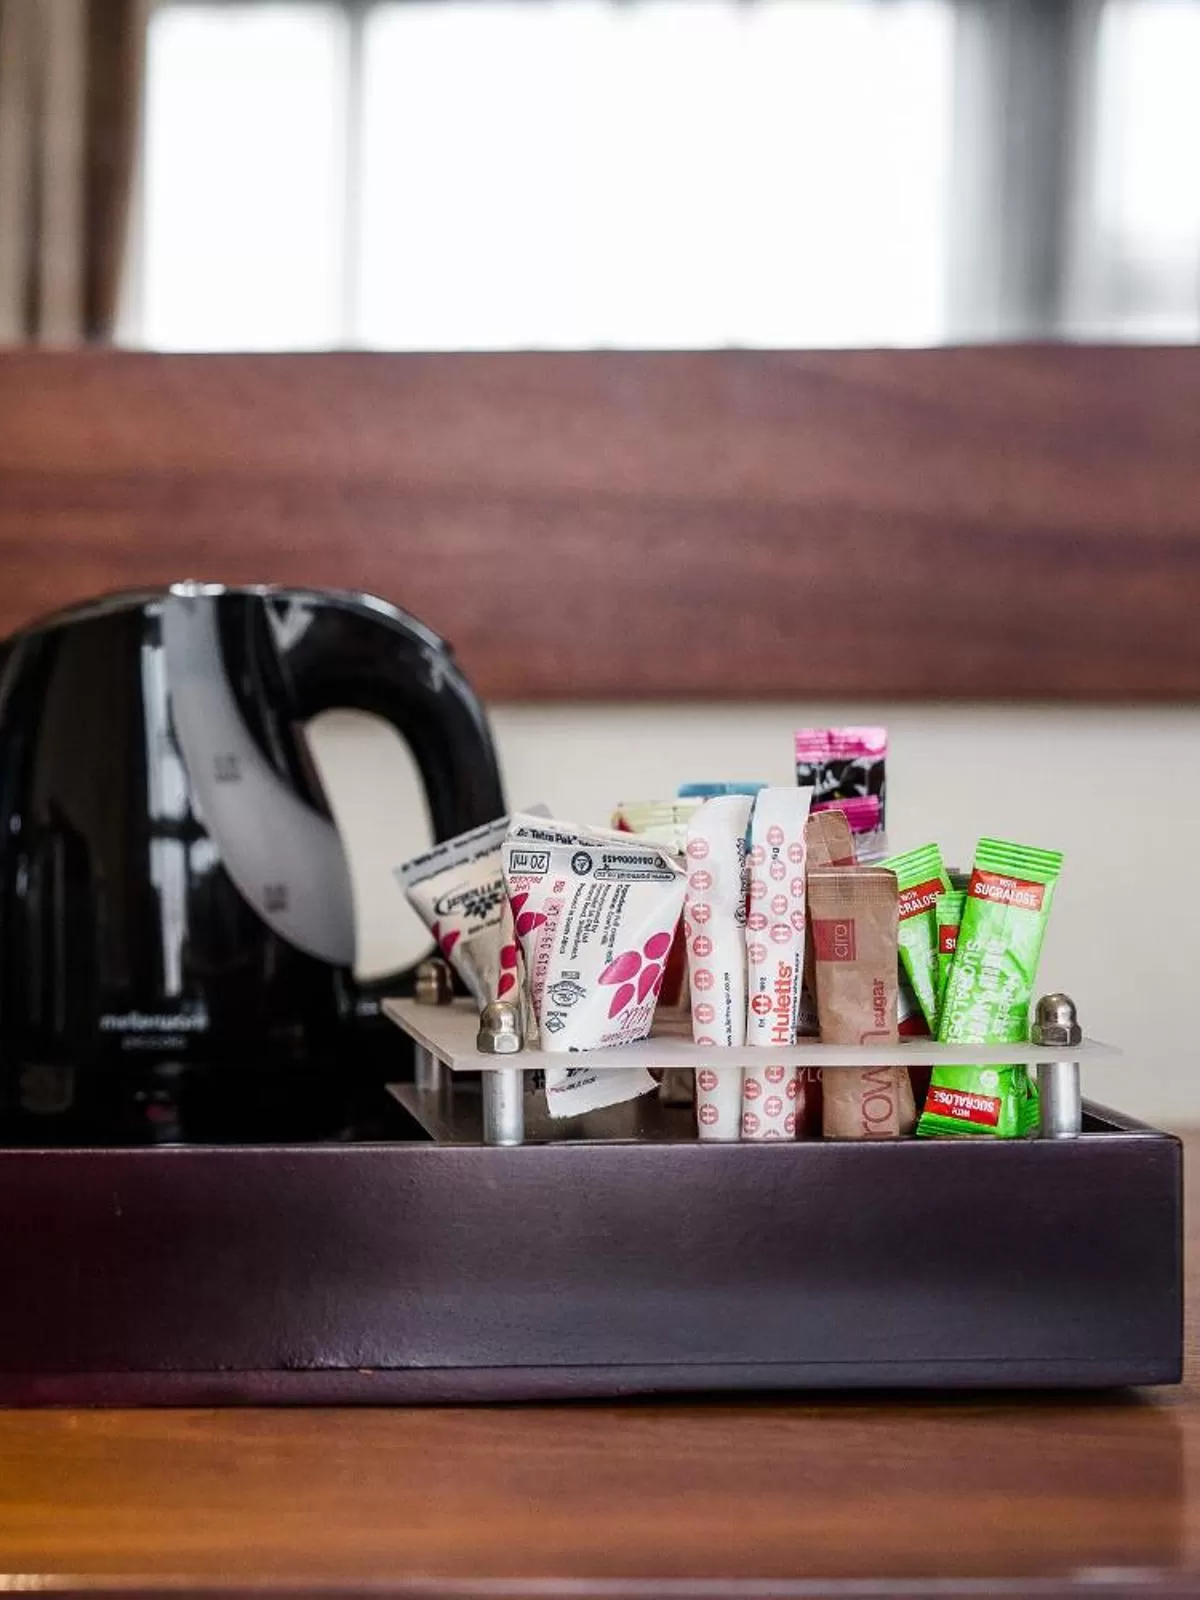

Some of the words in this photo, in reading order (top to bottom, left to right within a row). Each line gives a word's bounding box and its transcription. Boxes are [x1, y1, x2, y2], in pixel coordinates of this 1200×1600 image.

[512, 854, 528, 869] ml
[530, 855, 546, 869] 20
[899, 891, 941, 916] CRALOSE
[974, 882, 1038, 907] SUCRALOSE
[771, 965, 793, 1045] Huletts
[873, 978, 888, 1028] sugar
[860, 1029, 895, 1137] rown
[933, 1090, 996, 1113] SUCRALOSE
